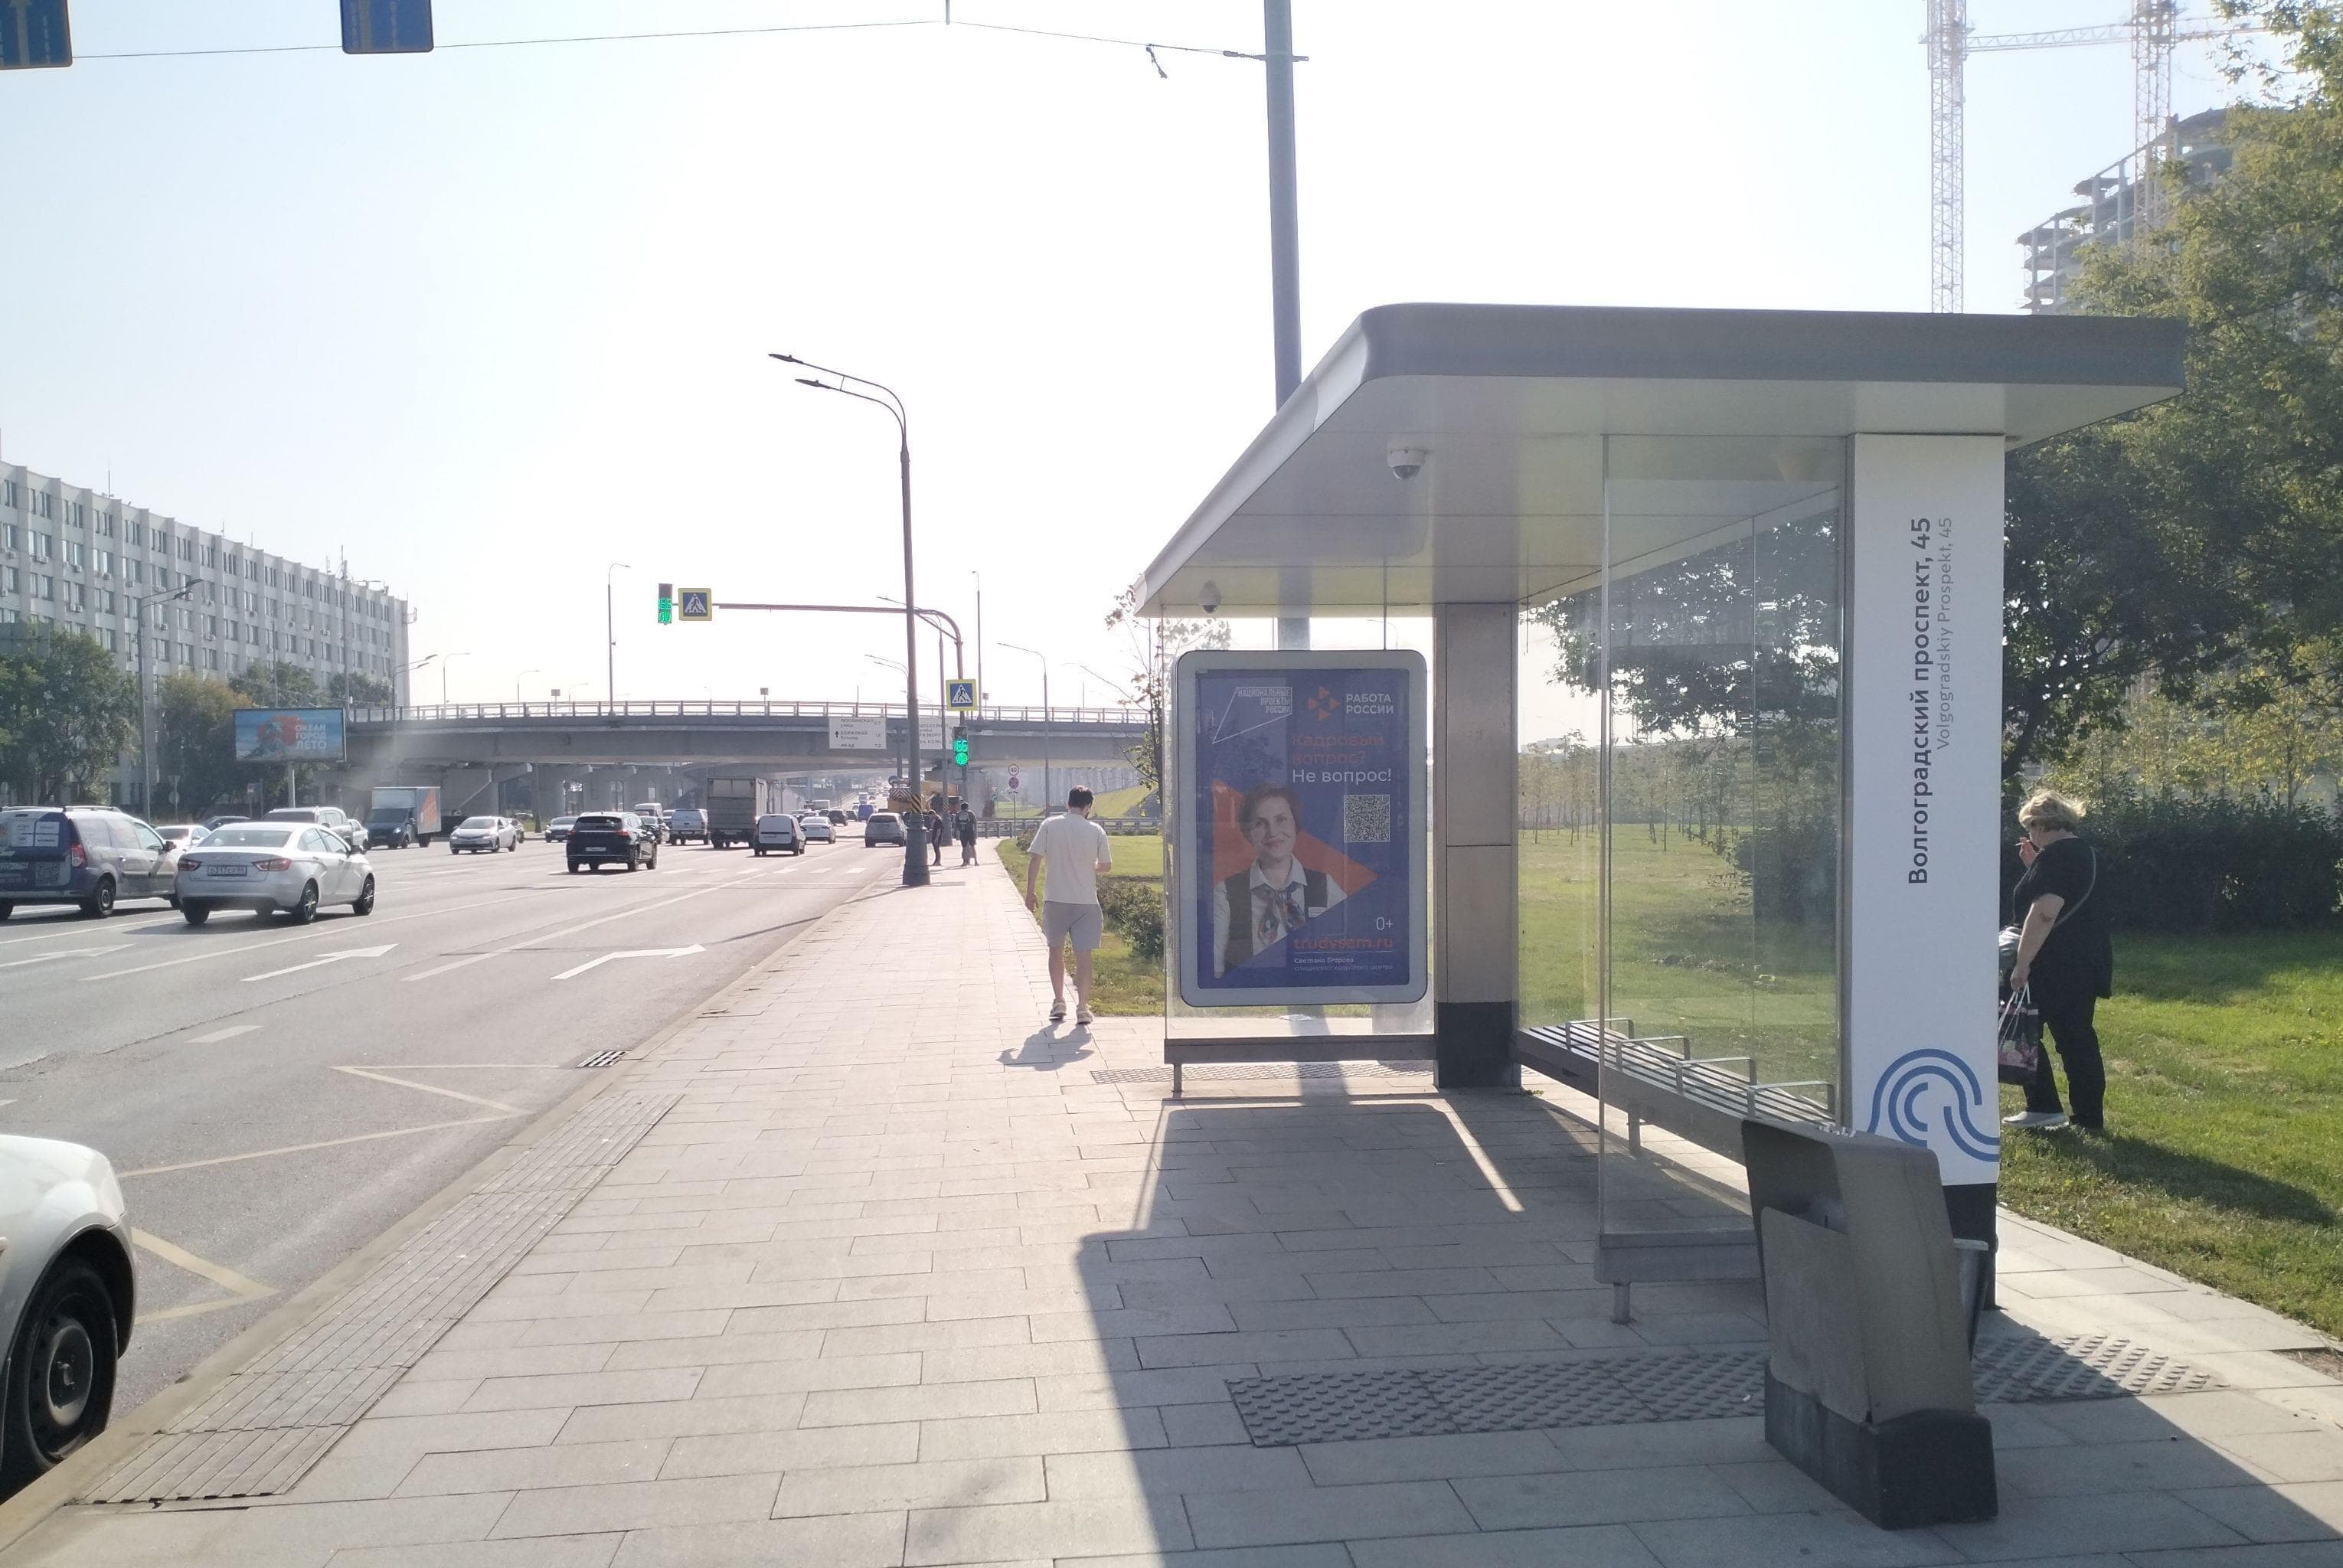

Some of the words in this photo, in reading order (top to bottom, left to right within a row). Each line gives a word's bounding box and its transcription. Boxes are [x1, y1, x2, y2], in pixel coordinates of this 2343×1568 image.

[1910, 518, 1930, 550] 45
[1939, 518, 1952, 538] 45
[1937, 544, 1954, 622] Prospekt,
[1915, 557, 1934, 681] проспект,
[1237, 688, 1290, 697] НАЦИОНАЛЬНЫЕ
[1936, 628, 1954, 750] Volgogradskiy
[1260, 697, 1290, 706] ПРОЕКТЫ
[1345, 693, 1392, 703] РАБОТА
[1265, 705, 1290, 714] РОССИИ
[1345, 704, 1394, 714] РОССИИ
[296, 732, 326, 740] ГОРОД
[296, 740, 327, 750] ЛЕТО
[1292, 769, 1316, 782] Не
[1322, 768, 1392, 786] вопрос!
[1908, 689, 1933, 884] Волгоградский
[1376, 916, 1394, 930] 0+
